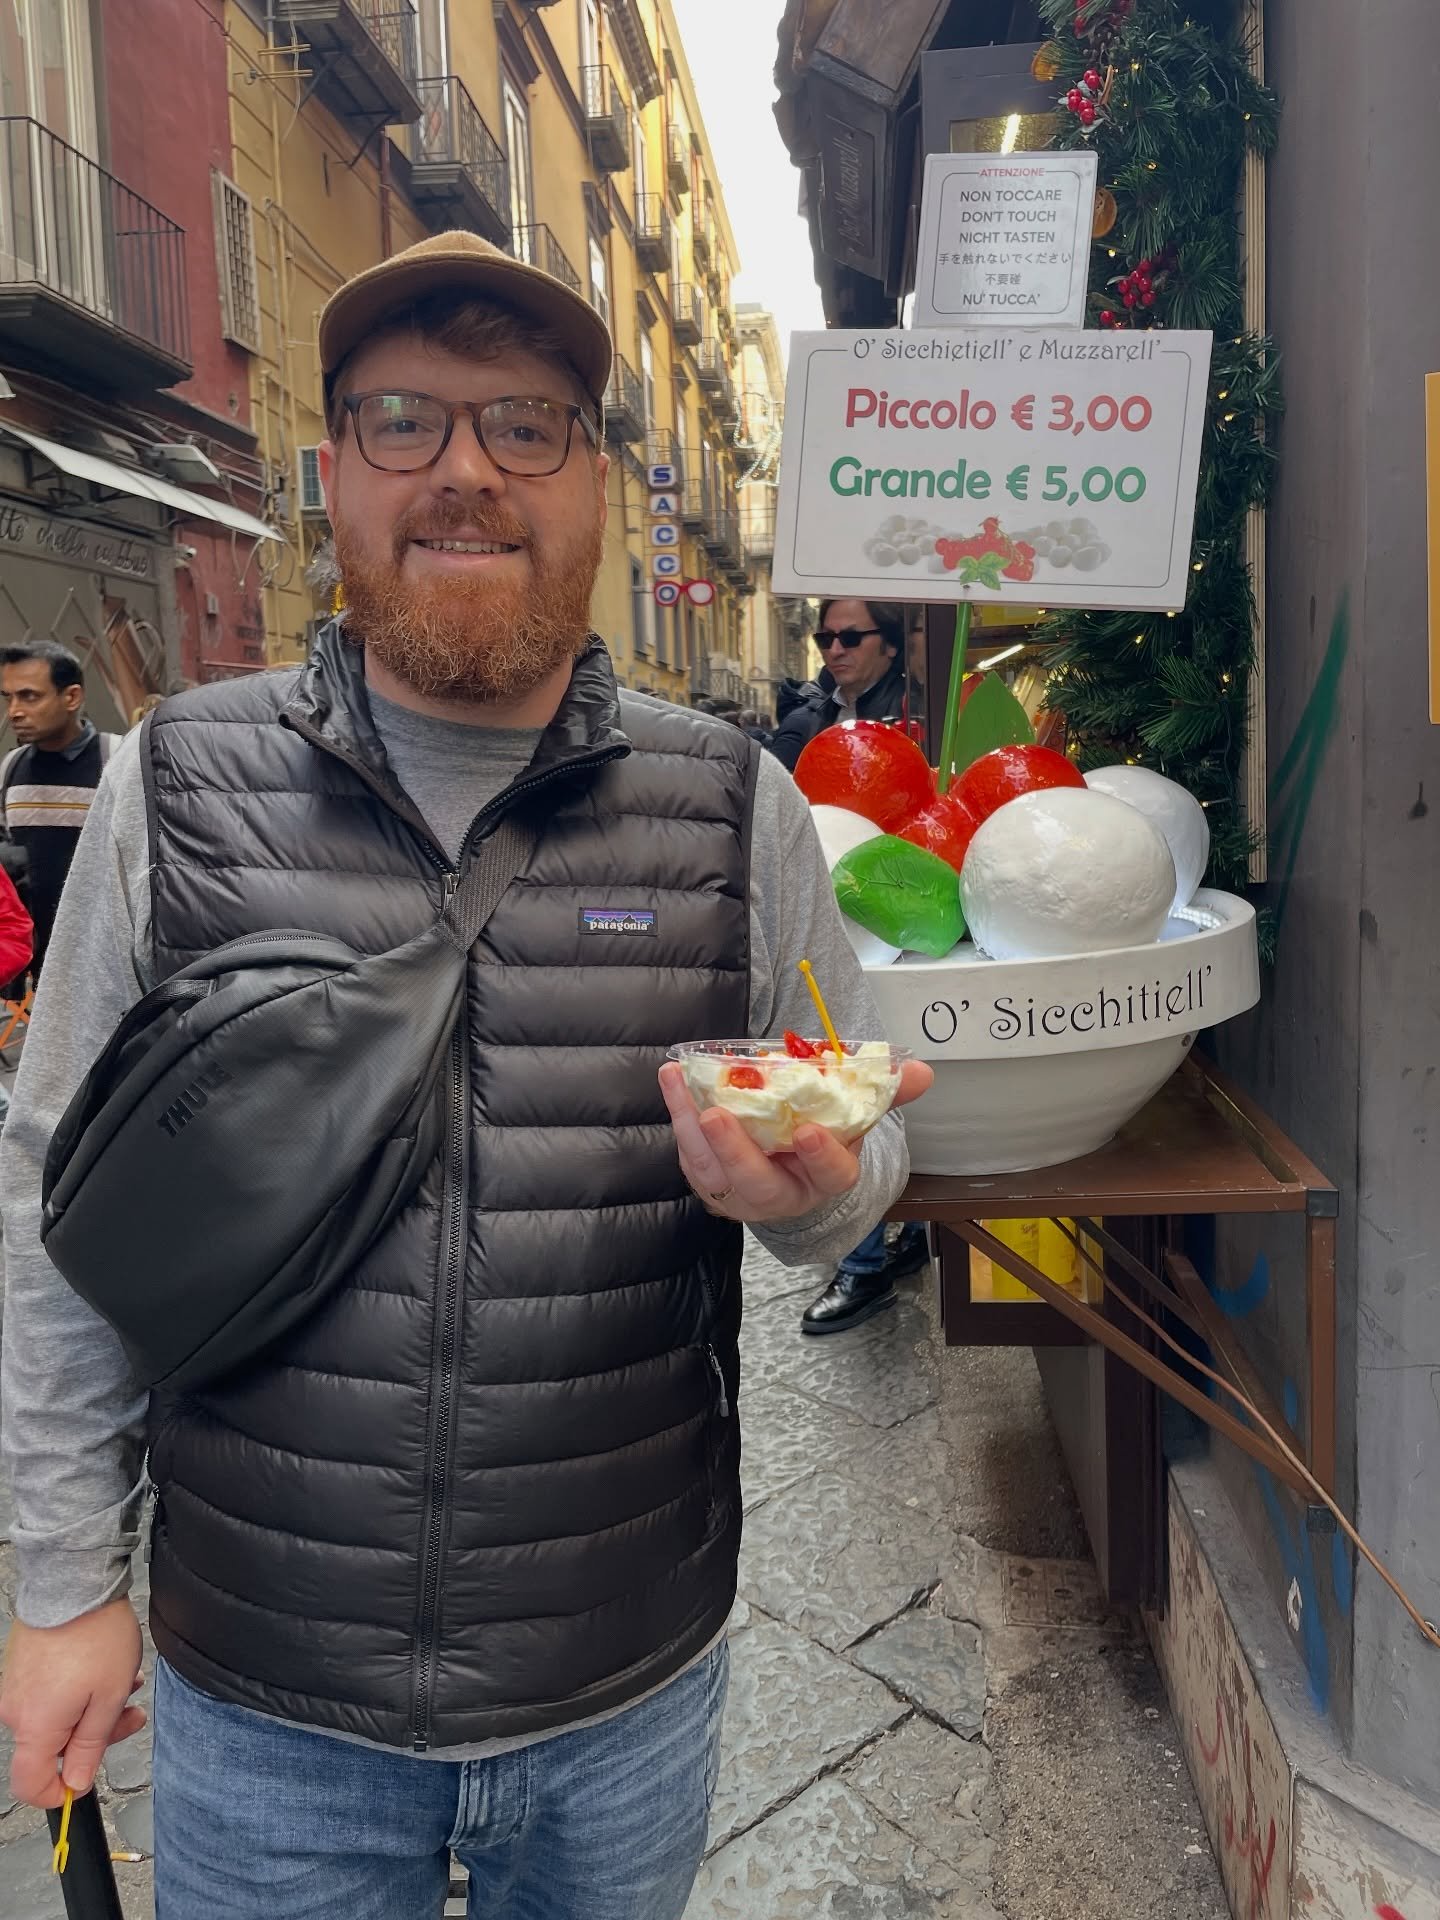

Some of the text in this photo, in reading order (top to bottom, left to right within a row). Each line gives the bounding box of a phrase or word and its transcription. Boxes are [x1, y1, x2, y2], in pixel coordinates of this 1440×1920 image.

[979, 167, 1045, 177] ATTENZIONE
[960, 189, 1062, 202] NON TOCCARE
[961, 210, 1056, 222] DON'T TOUCH
[959, 231, 1055, 244] NICHT TASTEN
[938, 253, 1072, 265] 手を触れないでください
[1019, 345, 1031, 362] e
[845, 387, 1153, 436] Piccolo € 3,00
[829, 455, 1147, 507] Grande € 5,00
[589, 921, 649, 932] patagonia
